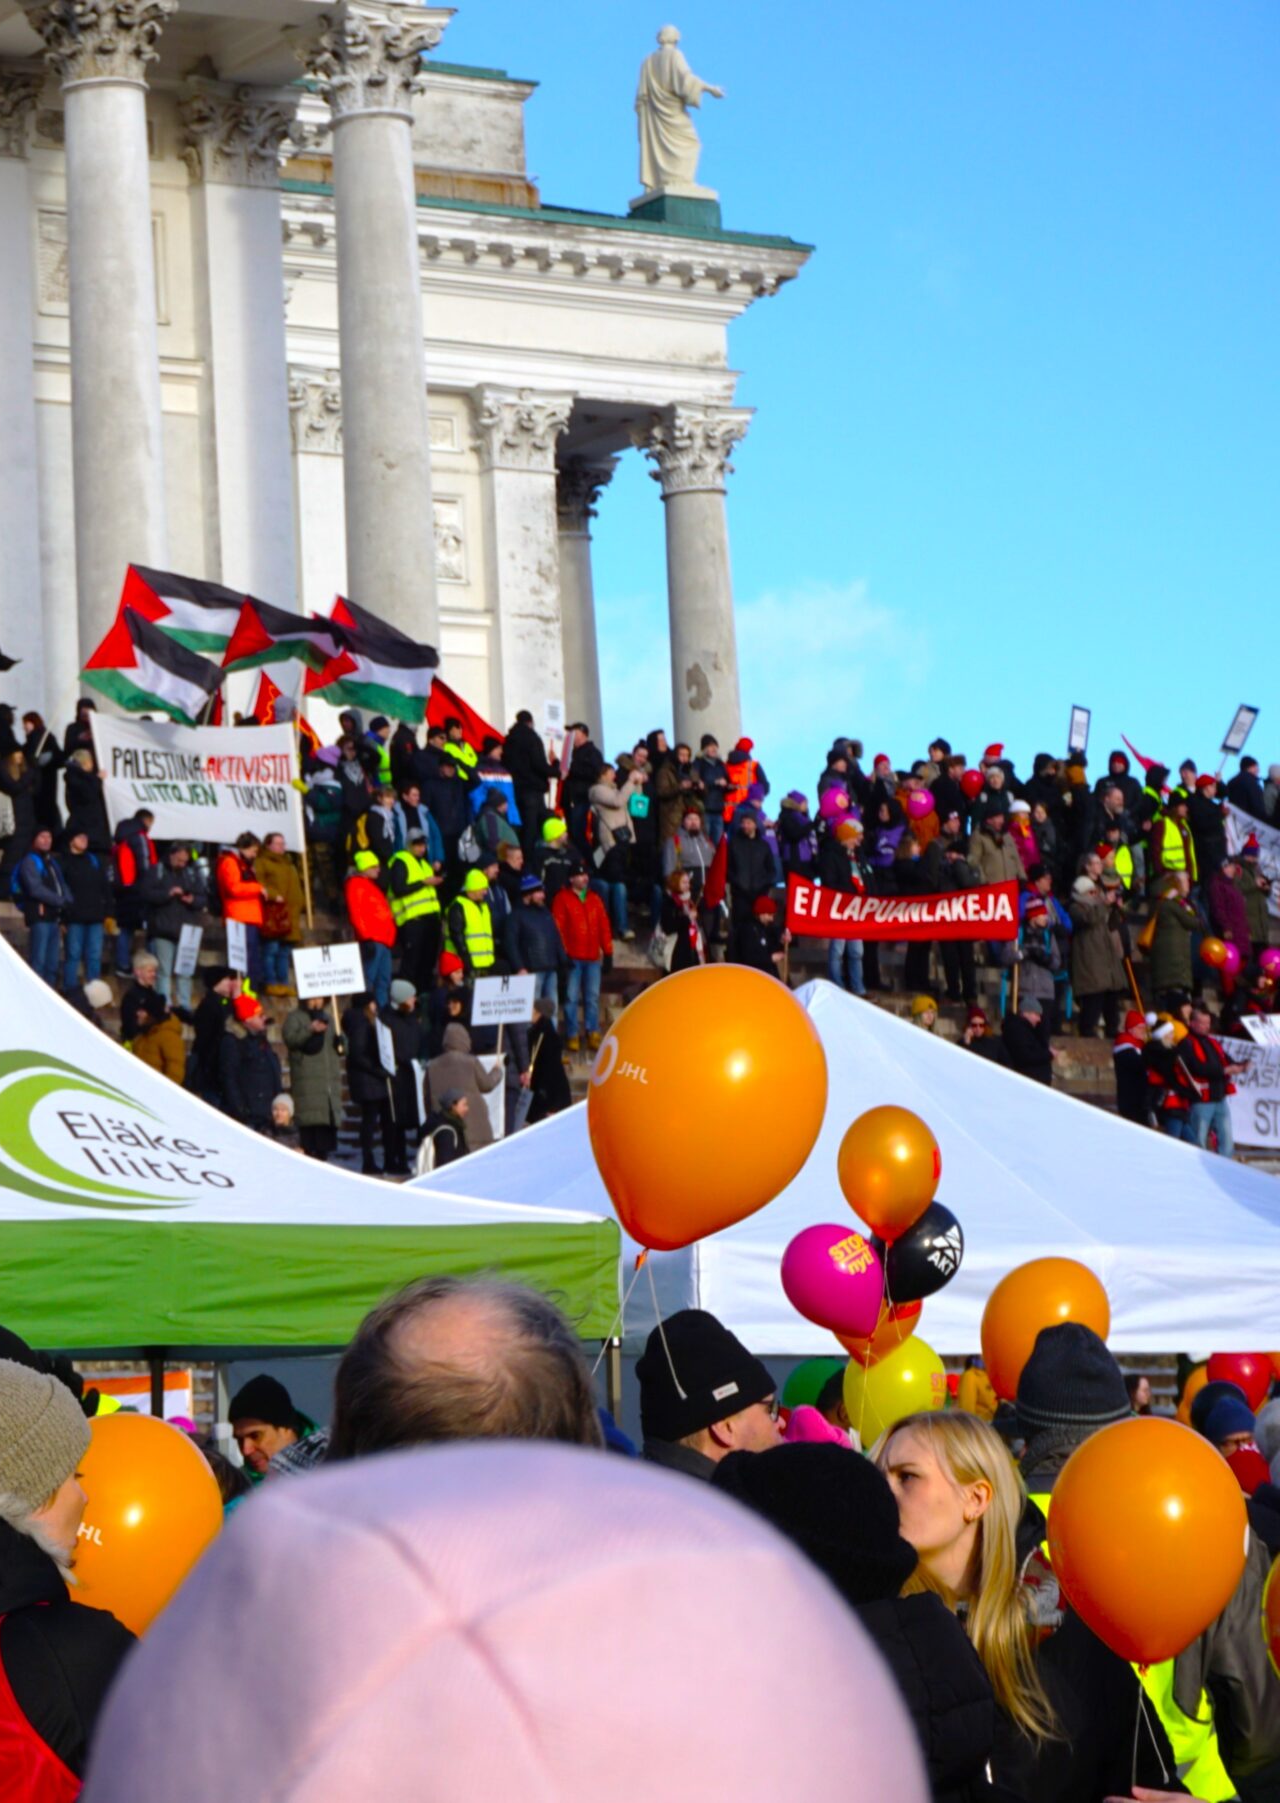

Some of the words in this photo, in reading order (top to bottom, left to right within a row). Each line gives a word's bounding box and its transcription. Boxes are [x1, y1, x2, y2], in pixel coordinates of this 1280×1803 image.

[225, 783, 289, 812] TUKENA
[793, 886, 822, 918] EI
[829, 892, 1015, 923] LAPUANLAKEJA
[616, 1061, 649, 1085] JHL
[56, 1110, 221, 1159] Eläke-
[80, 1146, 236, 1189] liitto
[927, 1250, 956, 1277] AKT
[76, 1521, 104, 1547] HL
